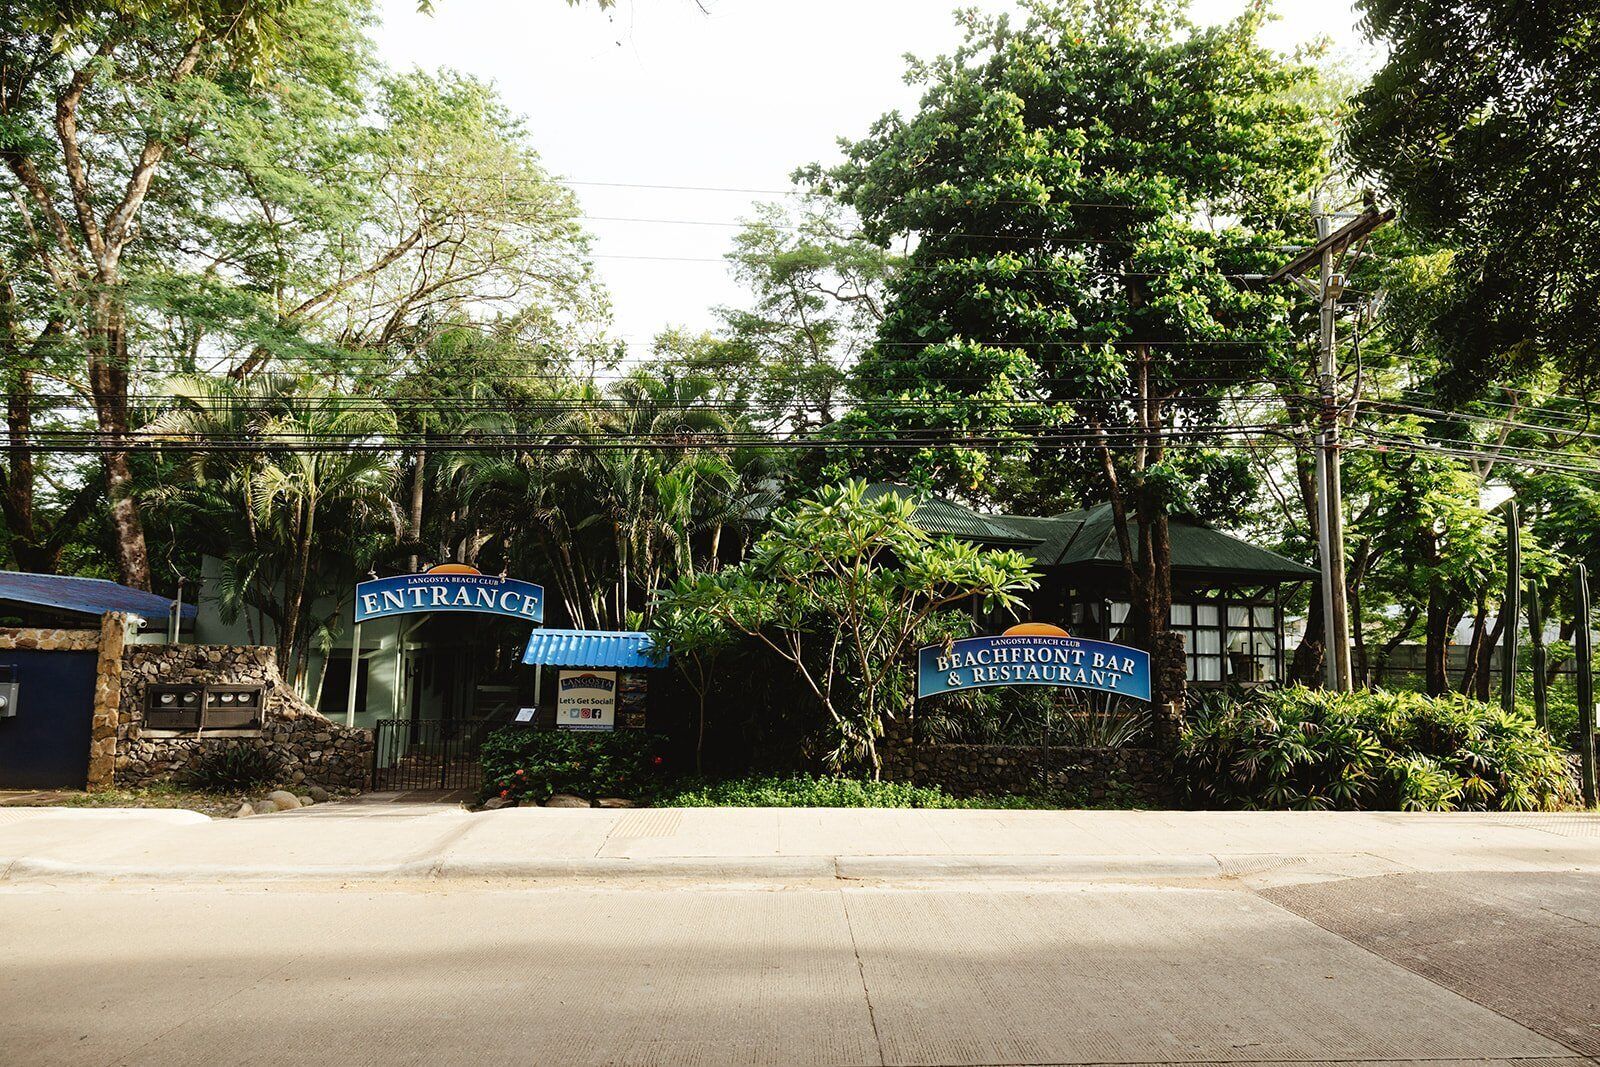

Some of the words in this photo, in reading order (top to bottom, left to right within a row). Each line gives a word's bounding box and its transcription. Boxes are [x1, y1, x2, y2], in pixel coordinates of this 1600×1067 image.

[407, 577, 450, 585] LANGOSTA
[479, 578, 499, 586] CLUB
[361, 586, 538, 616] ENTRANCE
[990, 638, 1032, 646] LANGOSTA
[1033, 638, 1059, 646] BEACH
[1059, 639, 1081, 648] CLUB
[936, 647, 1085, 672] BEACHFRONT
[1092, 652, 1136, 675] BAR
[562, 677, 612, 687] LANGOSTA
[947, 671, 963, 687] &
[972, 665, 1122, 689] RESTAURANT
[559, 697, 576, 705] Let's
